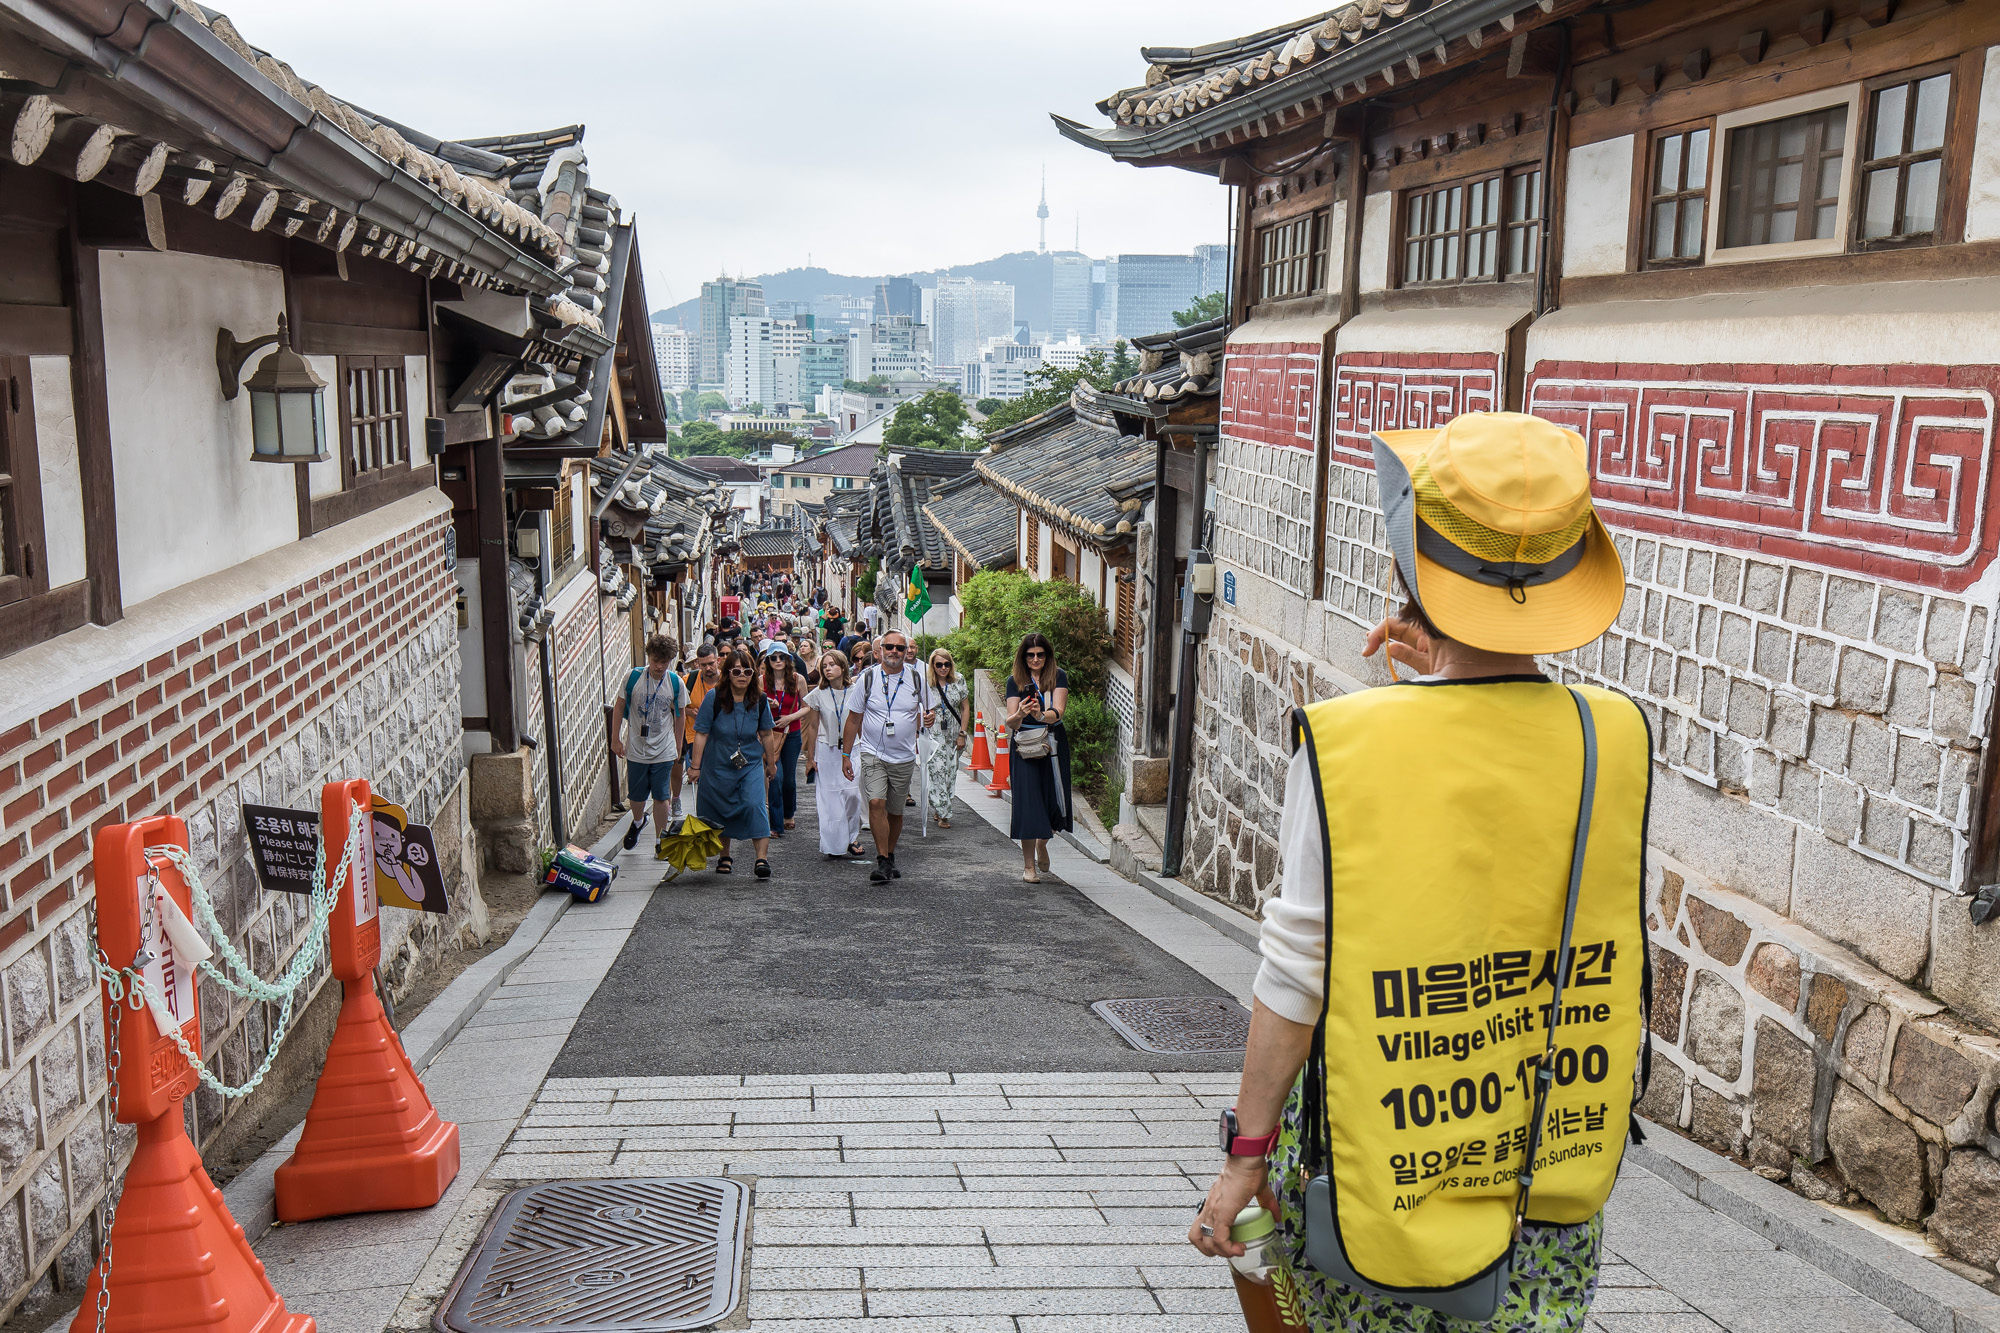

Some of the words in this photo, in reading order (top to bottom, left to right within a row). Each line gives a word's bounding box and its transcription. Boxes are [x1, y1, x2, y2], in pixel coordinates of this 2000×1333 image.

[254, 816, 295, 837] 조용히
[258, 835, 293, 849] Please
[294, 840, 316, 852] talk
[559, 872, 592, 892] coupang
[157, 896, 180, 1021] 차금지
[1377, 1029, 1486, 1062] Village
[1486, 1006, 1534, 1045] Visit
[1538, 1000, 1611, 1029] Time
[1380, 1044, 1609, 1130] 10:00~1700
[1389, 1139, 1487, 1186] 일요일은
[1494, 1123, 1543, 1164] 골목
[1393, 1176, 1460, 1211] Alleys
[1463, 1176, 1489, 1188] are
[1493, 1164, 1525, 1185] Close
[1533, 1157, 1547, 1171] on
[1549, 1142, 1603, 1165] Sundays
